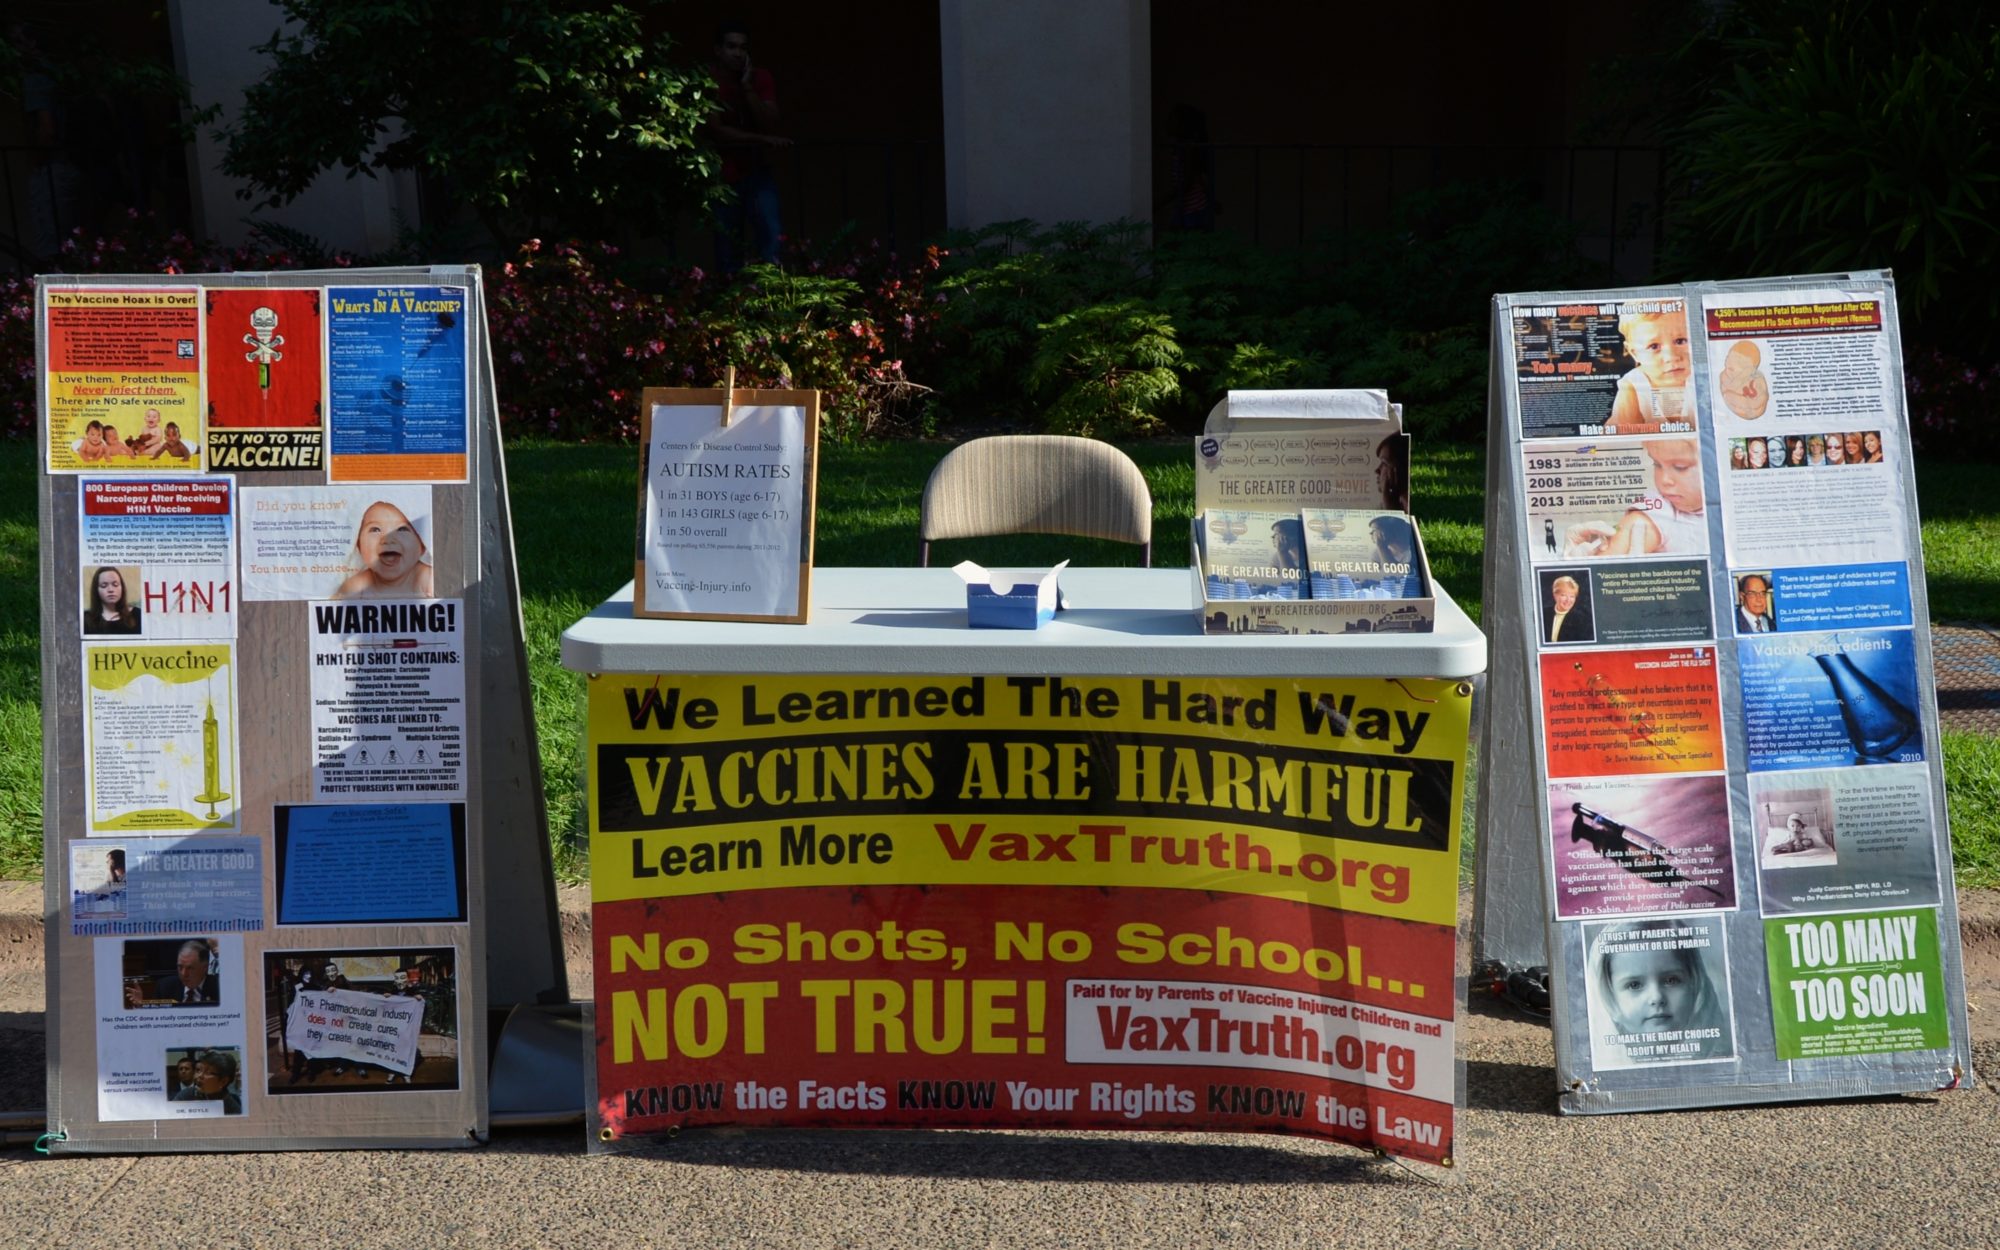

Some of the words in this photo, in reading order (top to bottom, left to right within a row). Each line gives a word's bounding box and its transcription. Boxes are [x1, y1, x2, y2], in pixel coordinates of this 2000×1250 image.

[51, 295, 71, 304] The
[74, 295, 119, 304] Vaccine
[122, 295, 151, 304] Hoax
[167, 295, 196, 304] Over!
[390, 298, 401, 313] A
[1532, 361, 1555, 374] Too
[121, 397, 140, 405] safe
[143, 397, 185, 405] vaccines!
[209, 434, 236, 445] SAY
[241, 434, 263, 445] NO
[267, 434, 285, 445] TO
[292, 434, 320, 445] THE
[661, 442, 688, 451] Centers
[690, 442, 701, 451] for
[703, 443, 733, 452] Disease
[734, 443, 761, 452] Control
[210, 446, 321, 468] VACCINE!
[1528, 458, 1562, 470] 1983
[659, 463, 729, 478] AUTISM
[734, 464, 791, 479] RATES
[85, 484, 103, 492] 800
[105, 484, 148, 493] European
[151, 483, 189, 492] Children
[192, 483, 228, 493] Develop
[1219, 480, 1240, 495] THE
[1244, 480, 1295, 495] GREATER
[1300, 479, 1331, 494] GOOD
[1335, 479, 1370, 494] MOVIE
[1529, 477, 1563, 488] 2008
[96, 495, 148, 504] Narcolepsy
[151, 494, 174, 502] After
[176, 494, 221, 503] Receiving
[660, 490, 664, 500] 1
[667, 490, 677, 500] in
[679, 490, 692, 500] 31
[696, 491, 728, 500] BOYS
[730, 491, 751, 503] (age
[753, 491, 780, 502] 6-17)
[1530, 496, 1564, 507] 2013
[1645, 498, 1663, 510] 50
[126, 505, 151, 513] H1N1
[154, 505, 191, 513] Vaccine
[659, 508, 663, 518] 1
[667, 508, 677, 518] in
[681, 508, 698, 518] 143
[701, 509, 735, 519] GIRLS
[738, 510, 759, 521] (age
[762, 510, 789, 521] 6-17)
[659, 526, 663, 536] 1
[667, 526, 676, 536] in
[679, 526, 692, 537] 50
[694, 527, 727, 537] overall
[1211, 564, 1229, 576] THE
[1233, 565, 1278, 579] GREATER
[1312, 561, 1331, 572] THE
[1334, 561, 1380, 574] GREATER
[1383, 563, 1411, 576] GOOD
[656, 579, 752, 593] Vaccine-Injury.info
[144, 581, 231, 613] H1N1
[1250, 604, 1386, 616] WWW.GREATERGOODMOVIE.ORG
[315, 603, 456, 634] WARNING!
[94, 653, 138, 671] HPV
[141, 650, 218, 669] vaccine
[316, 653, 343, 665] H1N1
[346, 653, 365, 665] FLU
[368, 652, 397, 665] SHOT
[400, 651, 460, 665] CONTAINS:
[338, 715, 379, 724] VACCINES
[381, 714, 396, 724] ARE
[398, 714, 427, 723] LINKED
[429, 714, 442, 723] TO:
[624, 687, 719, 731] We
[742, 676, 985, 726] Learned
[1007, 676, 1119, 718] The
[1142, 679, 1276, 731] Hard
[1299, 691, 1430, 754] Way
[1900, 753, 1921, 762] 2010
[625, 741, 935, 817] VACCINES
[958, 742, 1090, 801] ARE
[1116, 744, 1422, 833] HARMFUL
[632, 837, 762, 878] Learn
[780, 824, 893, 867] More
[934, 823, 1410, 904] VaxTruth.org
[1603, 932, 1627, 942] TRUST
[1628, 931, 1640, 940] MY
[1678, 928, 1693, 937] NOT
[1694, 926, 1709, 935] THE
[1599, 943, 1649, 954] GOVERNMENT
[1651, 943, 1662, 951] OR
[1663, 941, 1677, 950] BIG
[1678, 939, 1711, 949] PHARMA
[1784, 921, 1839, 968] TOO
[1842, 916, 1917, 964] MANY
[610, 933, 709, 973] No
[733, 921, 967, 970] Shots,
[995, 921, 1093, 963] No
[1116, 922, 1425, 998] School...
[1790, 977, 1846, 1022] TOO
[1850, 972, 1927, 1019] SOON
[300, 996, 315, 1008] The
[319, 999, 378, 1017] Pharmaceutical
[382, 1009, 413, 1023] industry
[1073, 983, 1106, 998] Paid
[1109, 984, 1131, 998] for
[1134, 985, 1153, 1002] by
[1158, 986, 1214, 1002] Parents
[1219, 989, 1234, 1002] of
[1237, 990, 1294, 1009] Vaccine
[1298, 997, 1347, 1018] Injured
[1351, 1007, 1410, 1030] Children
[1414, 1022, 1441, 1037] and
[307, 1013, 326, 1025] does
[331, 1017, 344, 1028] not
[348, 1020, 373, 1032] create
[377, 1024, 400, 1039] cures,
[612, 981, 779, 1064] NOT
[801, 979, 1046, 1054] TRUE!
[306, 1028, 323, 1042] they
[328, 1032, 352, 1043] create
[357, 1036, 398, 1053] customers.
[1605, 1036, 1616, 1045] TO
[1617, 1034, 1641, 1044] MAKE
[1641, 1033, 1656, 1042] THE
[1658, 1031, 1683, 1041] RIGHT
[1684, 1028, 1721, 1040] CHOICES
[1097, 1005, 1415, 1091] VaxTruth.org
[1627, 1047, 1655, 1057] ABOUT
[1656, 1045, 1669, 1055] MY
[1670, 1043, 1700, 1053] HEALTH
[624, 1082, 725, 1118] KNOW
[734, 1081, 787, 1110] the
[799, 1080, 886, 1110] Facts
[898, 1080, 997, 1111] KNOW
[1005, 1081, 1079, 1112] Your
[1090, 1081, 1196, 1119] Rights
[1207, 1084, 1306, 1119] KNOW
[1315, 1095, 1367, 1130] the
[1377, 1106, 1442, 1147] Law
